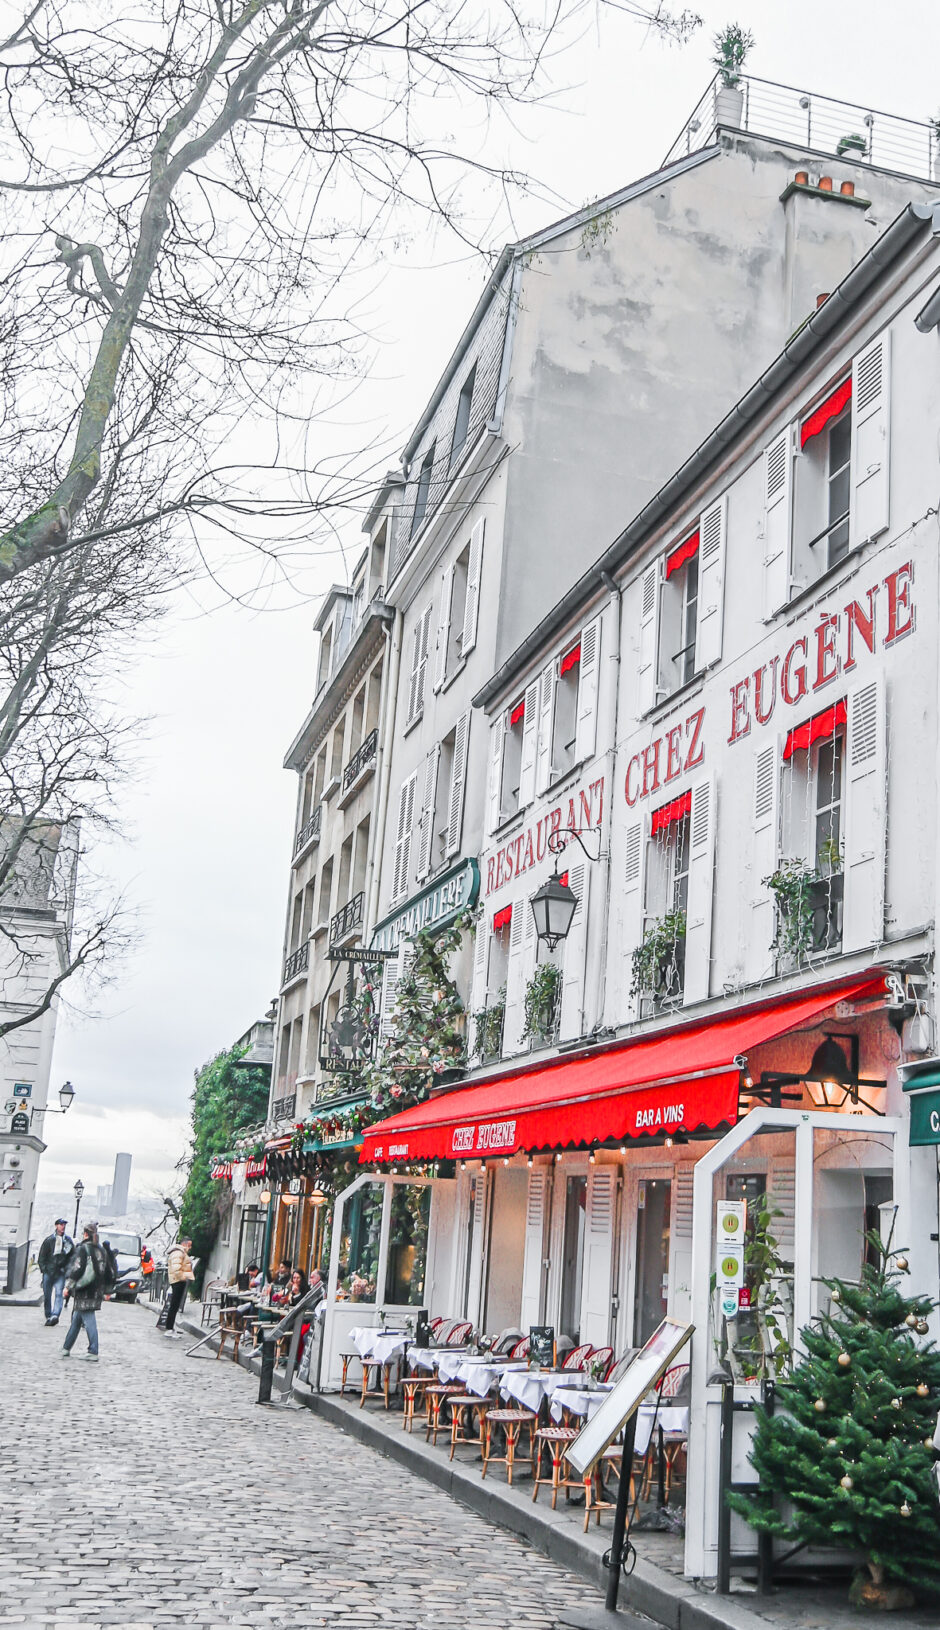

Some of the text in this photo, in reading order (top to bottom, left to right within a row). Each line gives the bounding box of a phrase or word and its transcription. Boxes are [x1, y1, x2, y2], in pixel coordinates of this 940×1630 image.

[486, 559, 917, 895] RESTAURANT CHEZ EUGÈNE
[333, 949, 343, 958] LA
[635, 1103, 685, 1128] BAR A VINS
[452, 1126, 475, 1152] CHEZ
